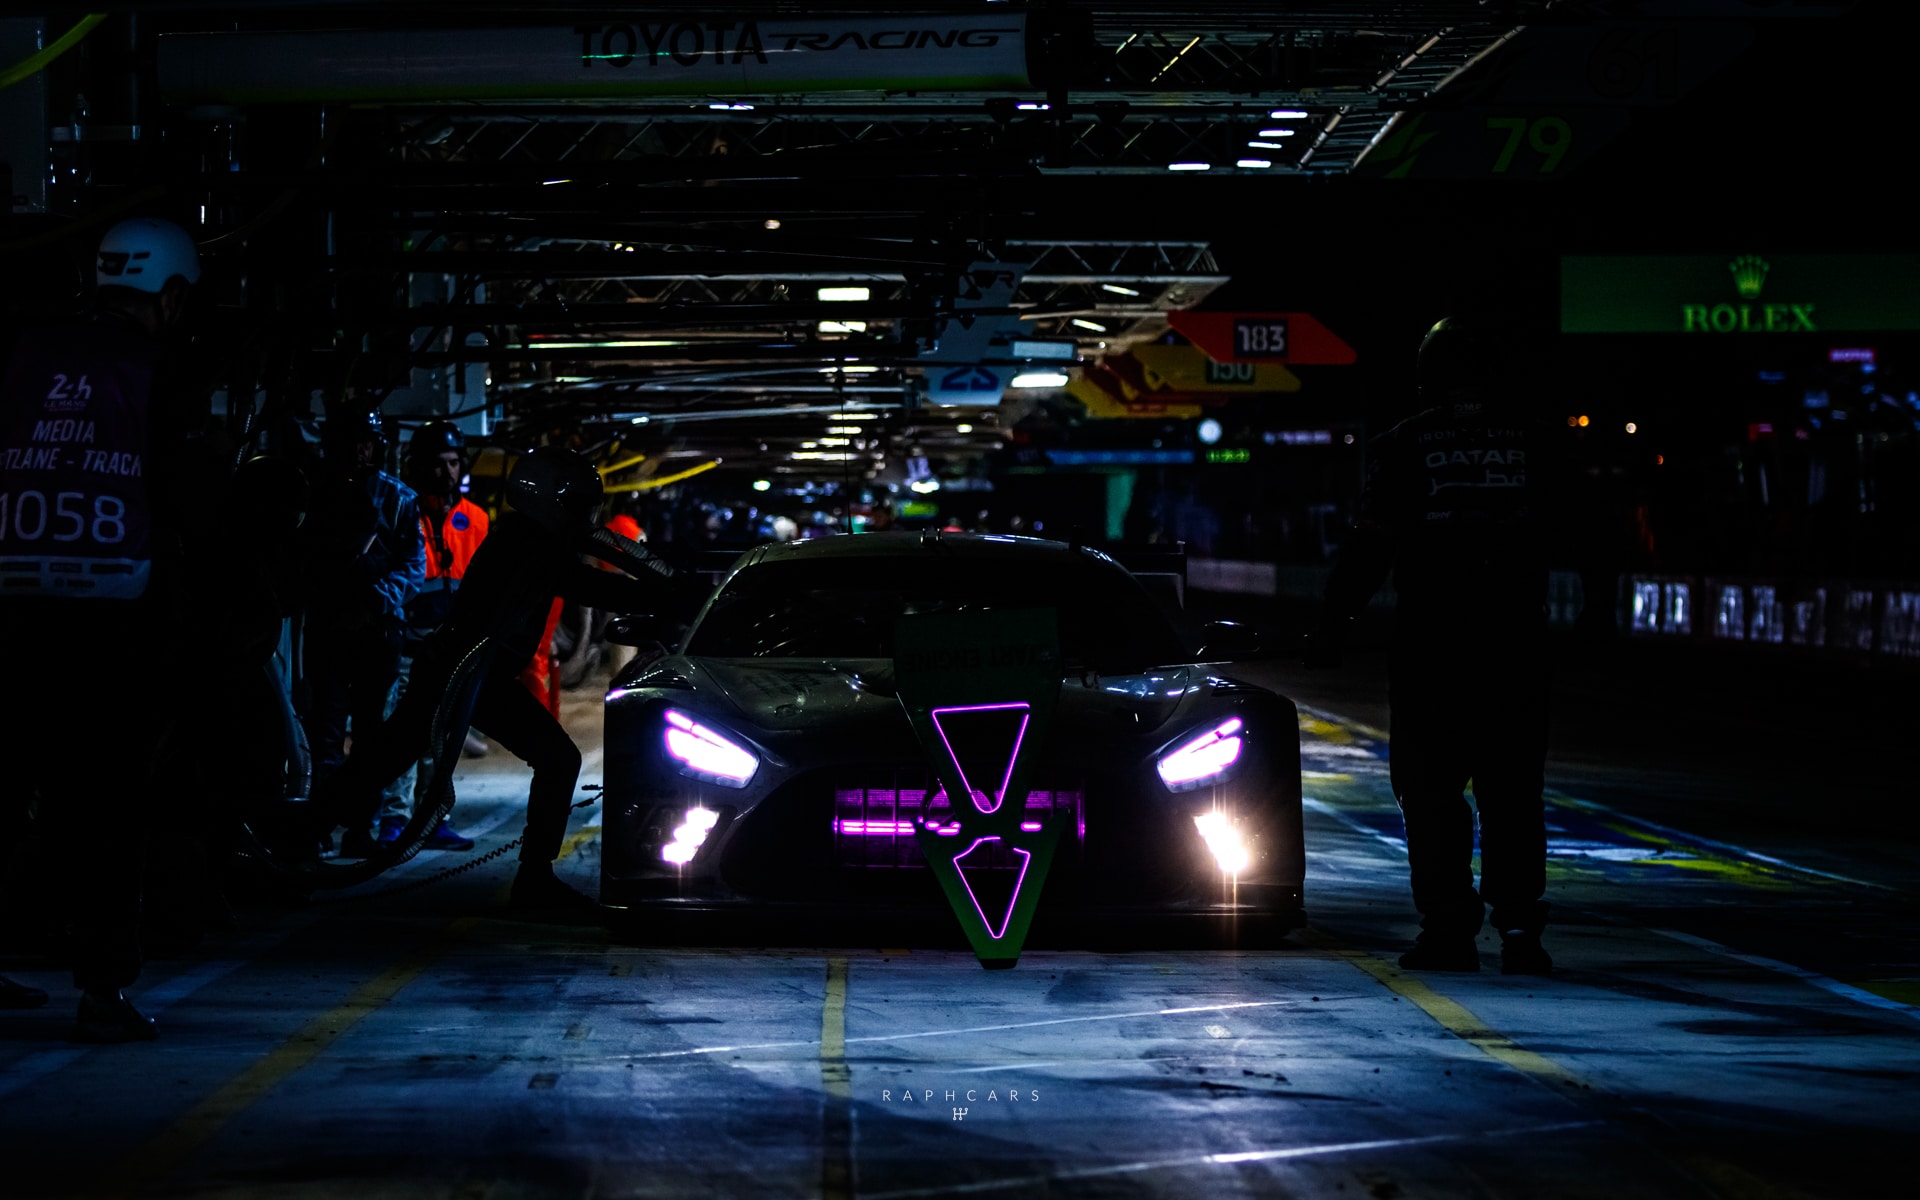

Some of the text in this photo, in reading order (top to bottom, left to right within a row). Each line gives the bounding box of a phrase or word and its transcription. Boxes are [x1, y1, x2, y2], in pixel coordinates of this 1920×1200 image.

[575, 22, 1018, 67] TOYOTA RACING
[1586, 29, 1681, 98] 61
[1485, 116, 1573, 174] 79
[1682, 303, 1818, 333] ROLEX
[1236, 325, 1285, 353] 183
[32, 419, 96, 443] MEDIA
[1425, 449, 1527, 468] QATAR
[0, 490, 126, 543] 1058
